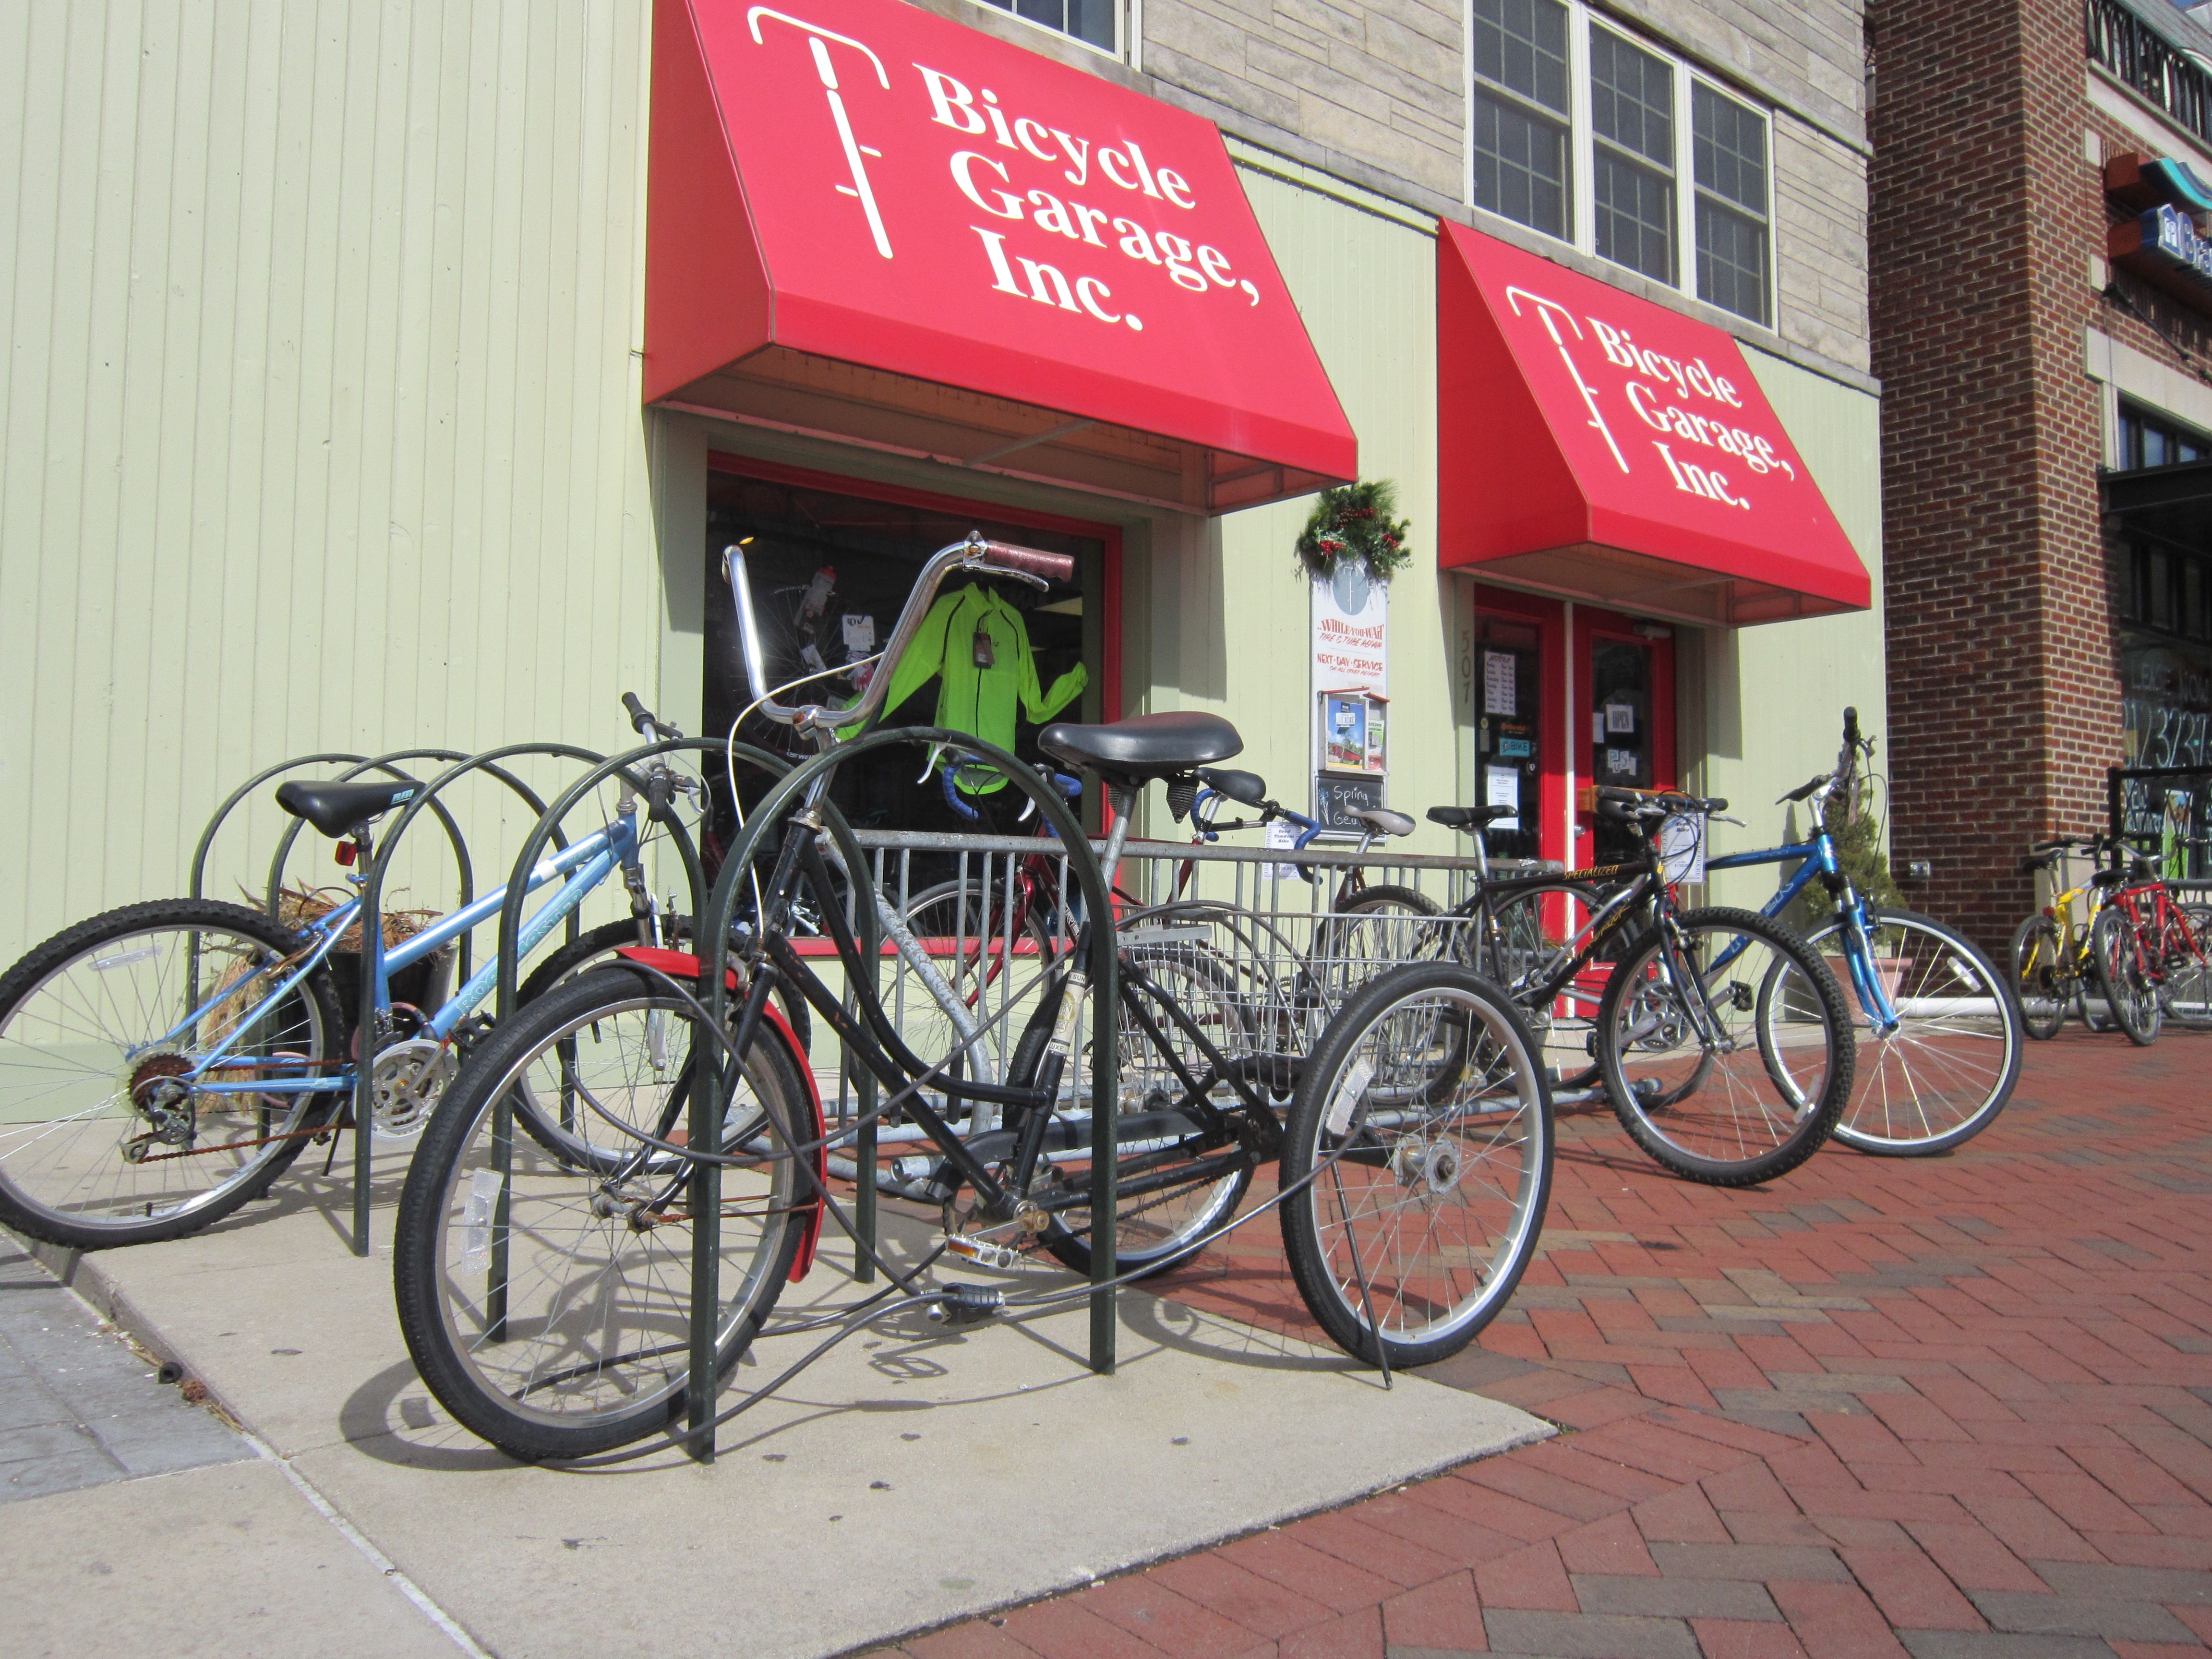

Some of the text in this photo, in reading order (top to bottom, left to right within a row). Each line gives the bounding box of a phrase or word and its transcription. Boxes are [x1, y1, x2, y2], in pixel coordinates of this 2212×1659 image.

[912, 62, 1196, 209] Bicycle
[950, 151, 1259, 306] Garage,
[970, 226, 1143, 331] Inc.
[1586, 316, 1743, 408] Bicycle
[1626, 381, 1794, 481] Garage,
[1652, 441, 1750, 510] Inc.
[1317, 653, 1383, 671] NEXT DAY SERVICE
[1319, 633, 1336, 642] TIRE
[1342, 636, 1362, 646] TUBE
[1360, 639, 1383, 649] REPAIR
[1333, 785, 1369, 806] Spring
[1563, 865, 1620, 881] SPECIALIZED
